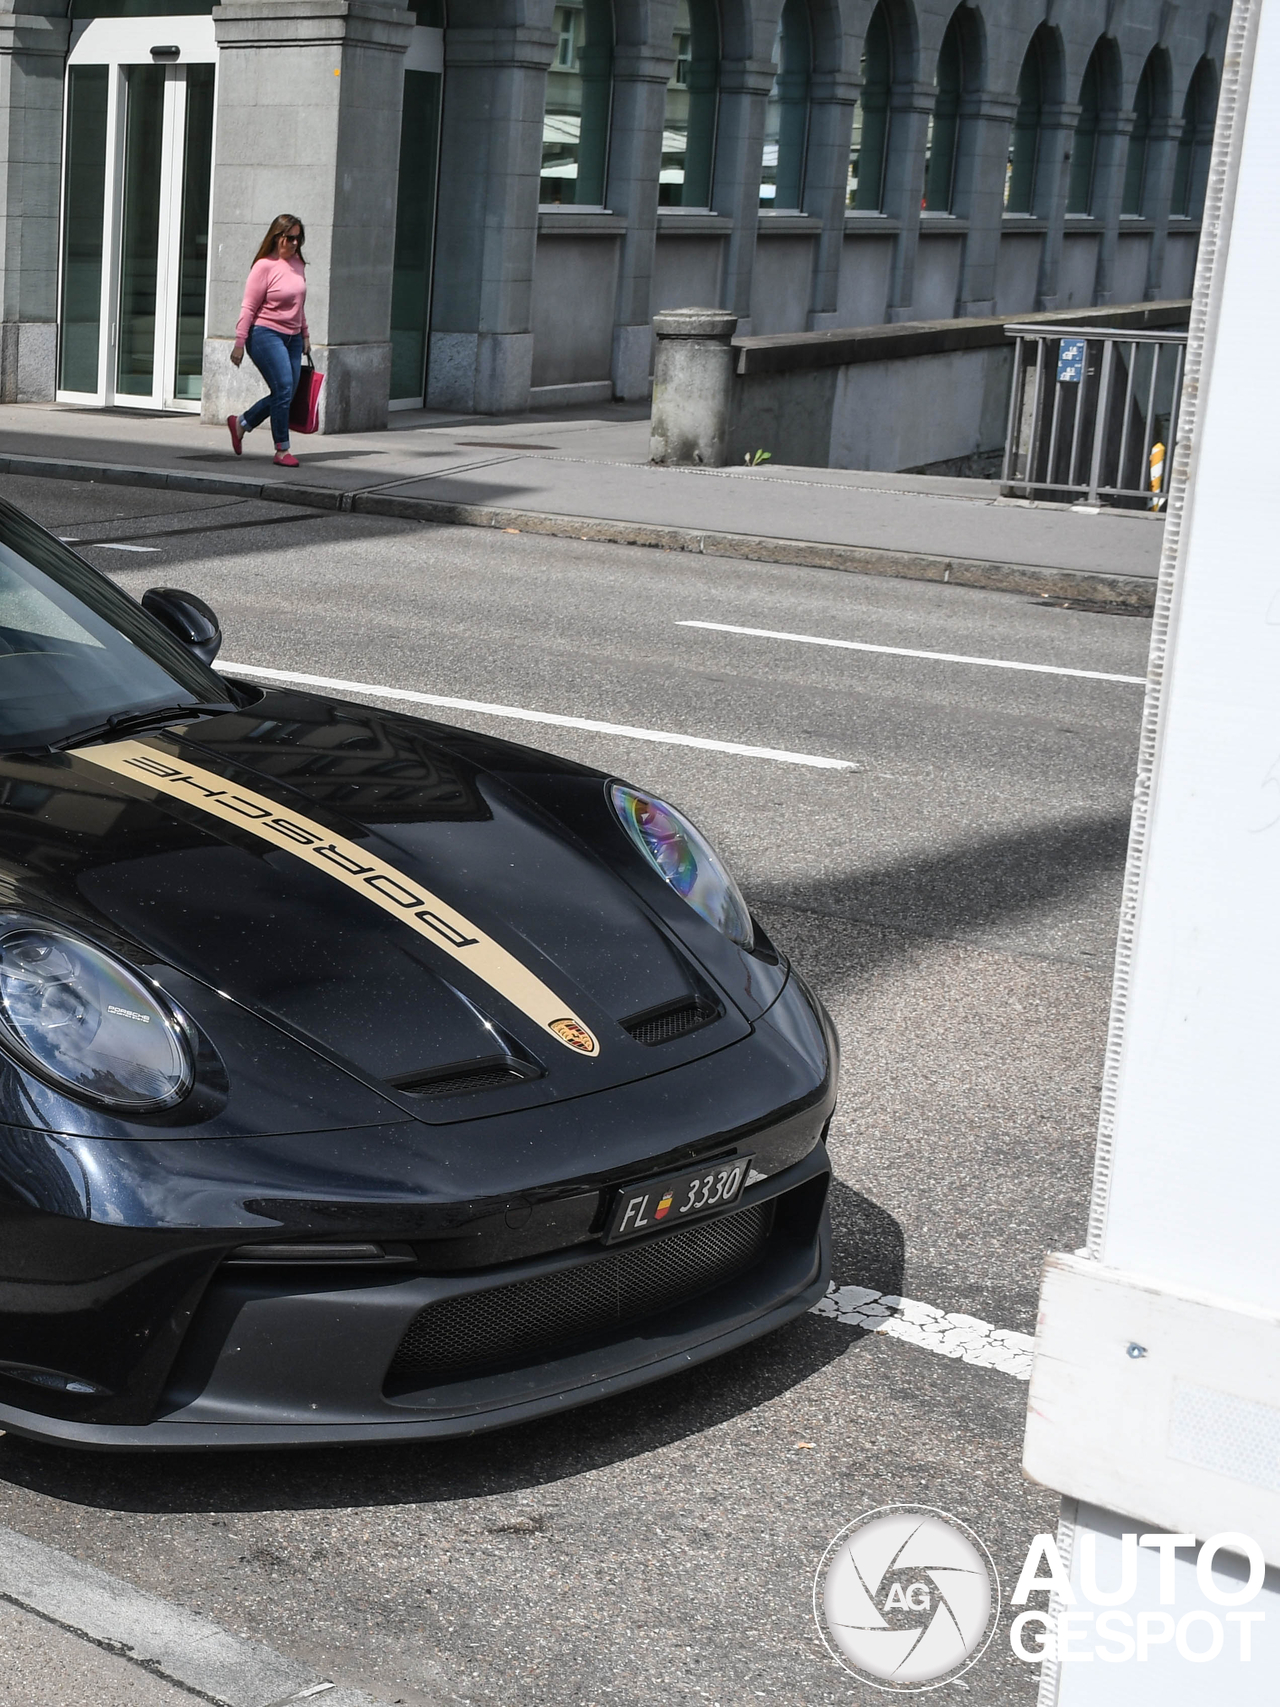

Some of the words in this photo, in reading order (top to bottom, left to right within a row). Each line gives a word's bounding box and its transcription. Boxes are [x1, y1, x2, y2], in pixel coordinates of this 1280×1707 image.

[122, 756, 480, 949] PORSCHE
[619, 1194, 650, 1232] FL
[679, 1167, 741, 1213] 3330
